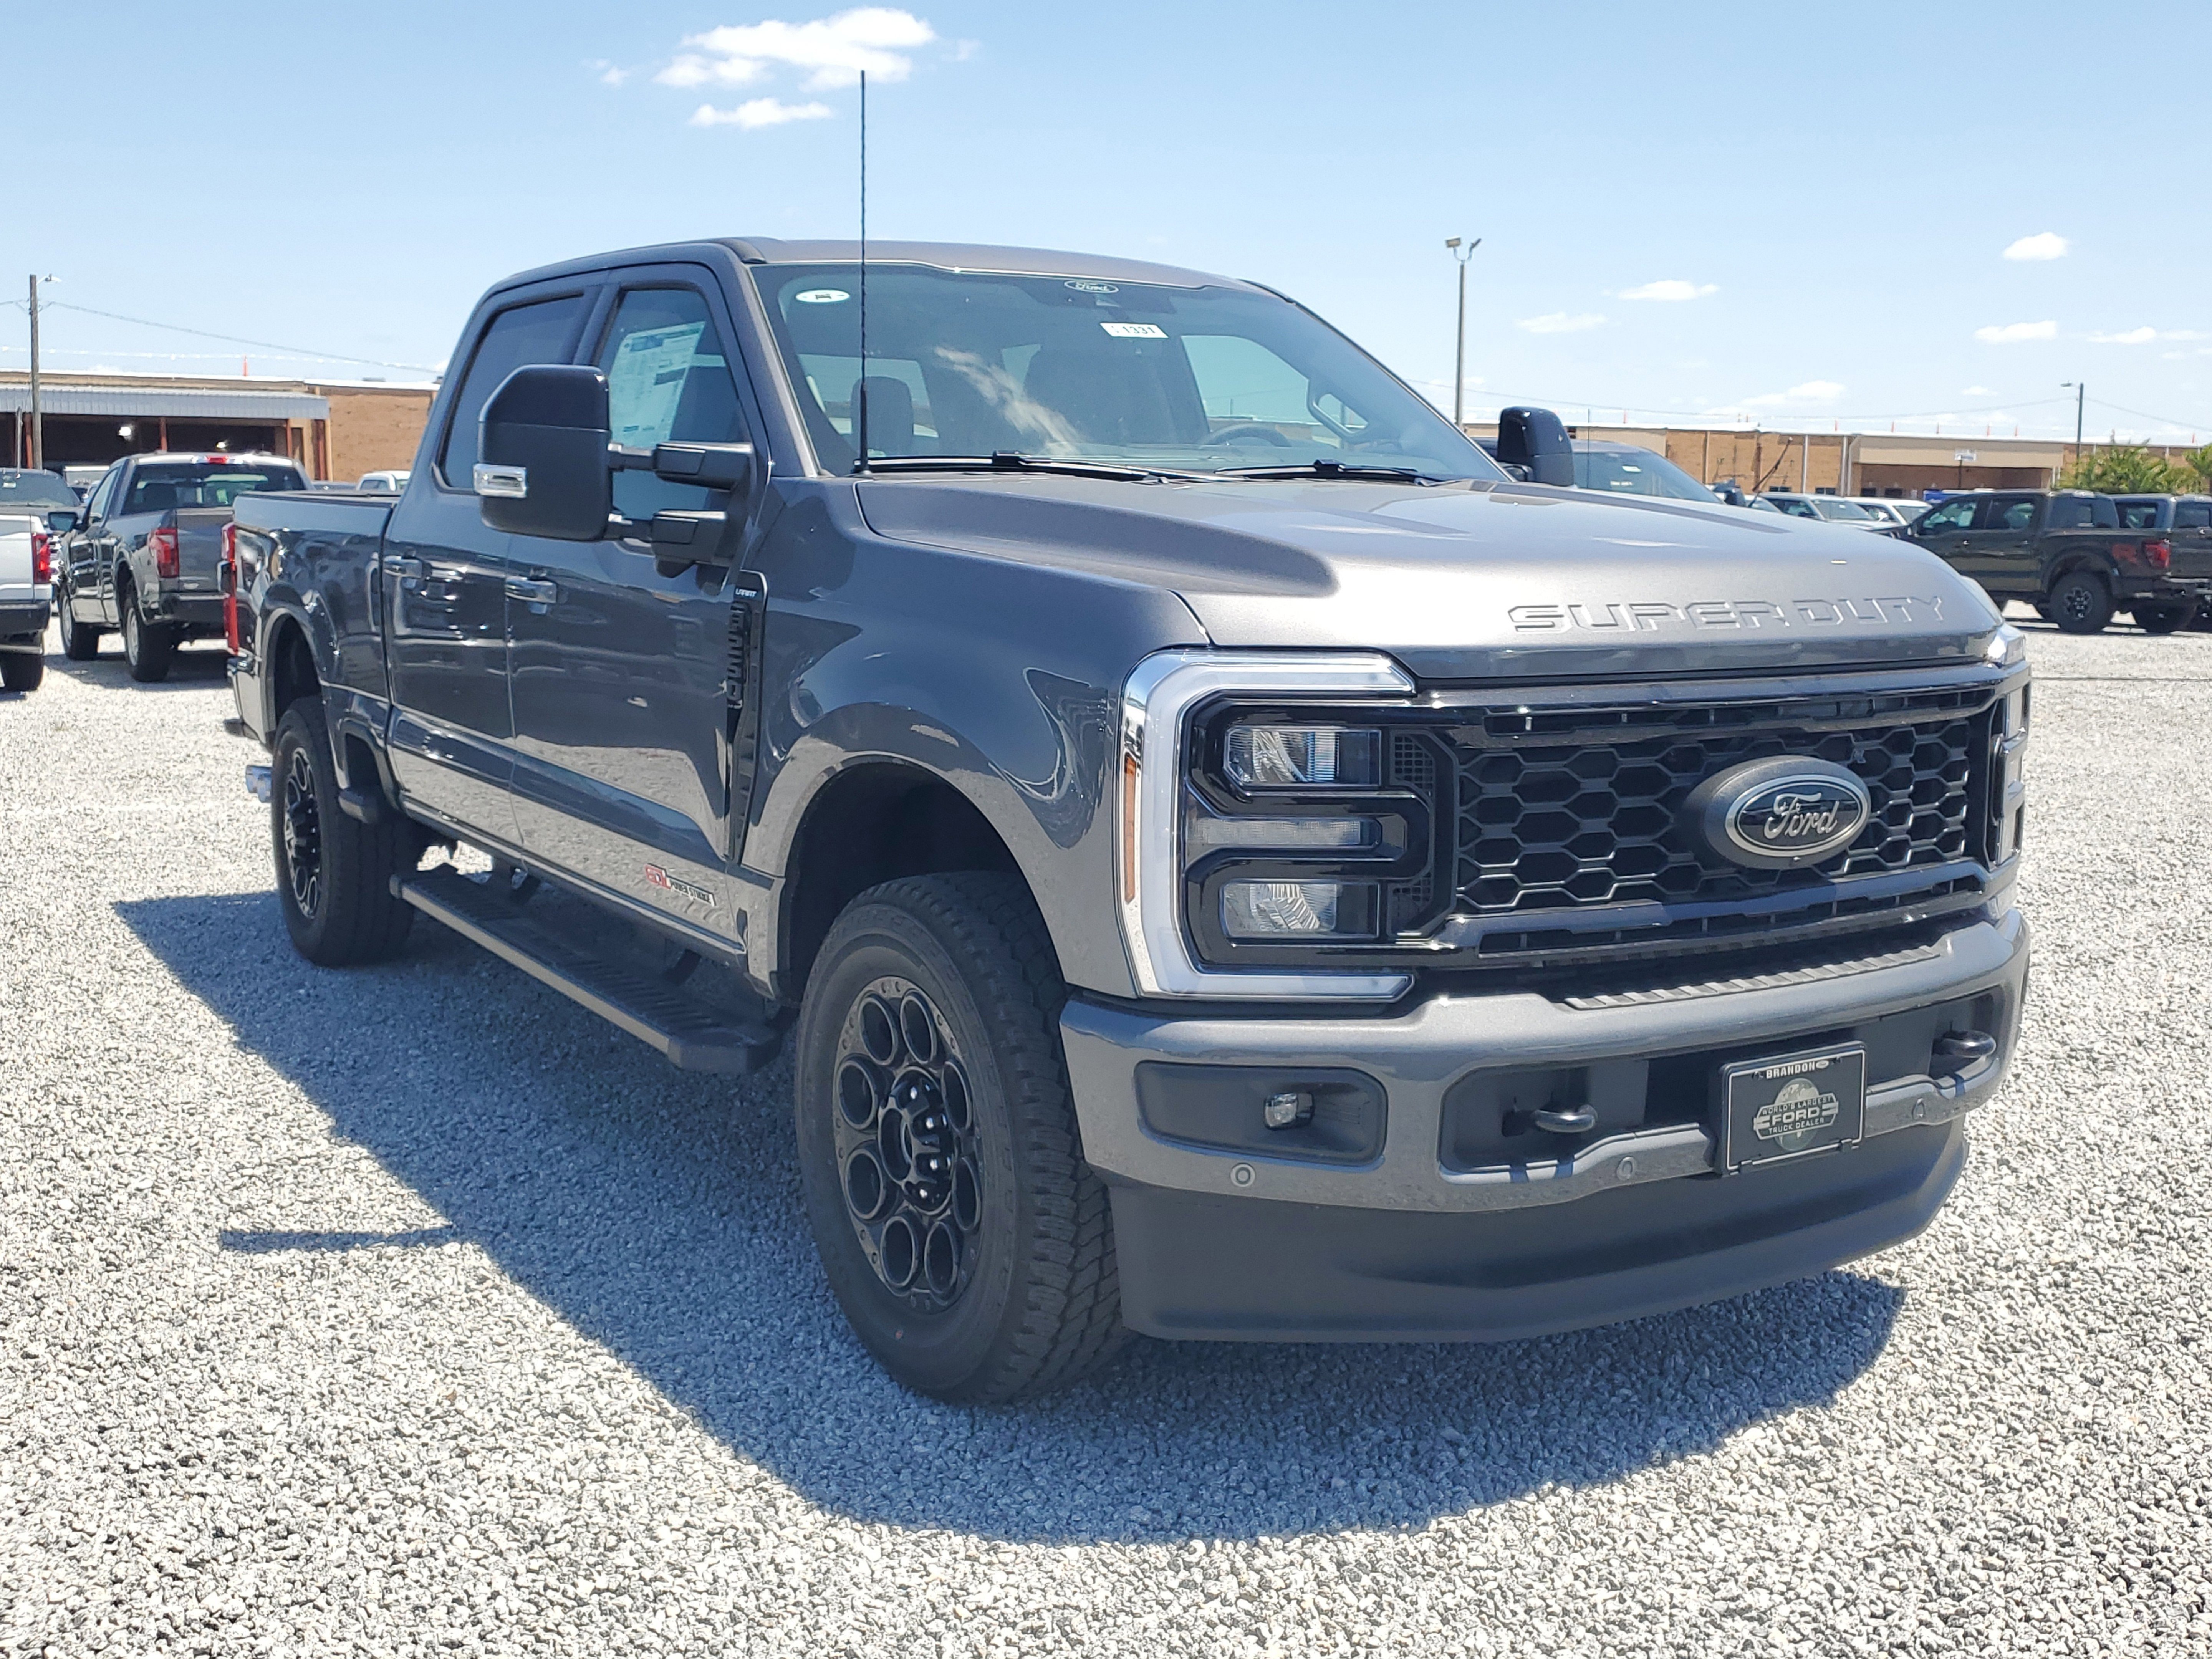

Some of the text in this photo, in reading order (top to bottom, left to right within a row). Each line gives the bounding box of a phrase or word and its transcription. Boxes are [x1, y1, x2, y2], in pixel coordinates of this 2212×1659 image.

[1508, 596, 1944, 632] SUPER DUTY
[1764, 792, 1840, 839] Ford
[1767, 1061, 1815, 1079] BRANDON
[1762, 1097, 1831, 1115] WORLD'S LARGEST
[1772, 1107, 1820, 1125] FORD
[1768, 1118, 1824, 1134] TRUCK DEALER
